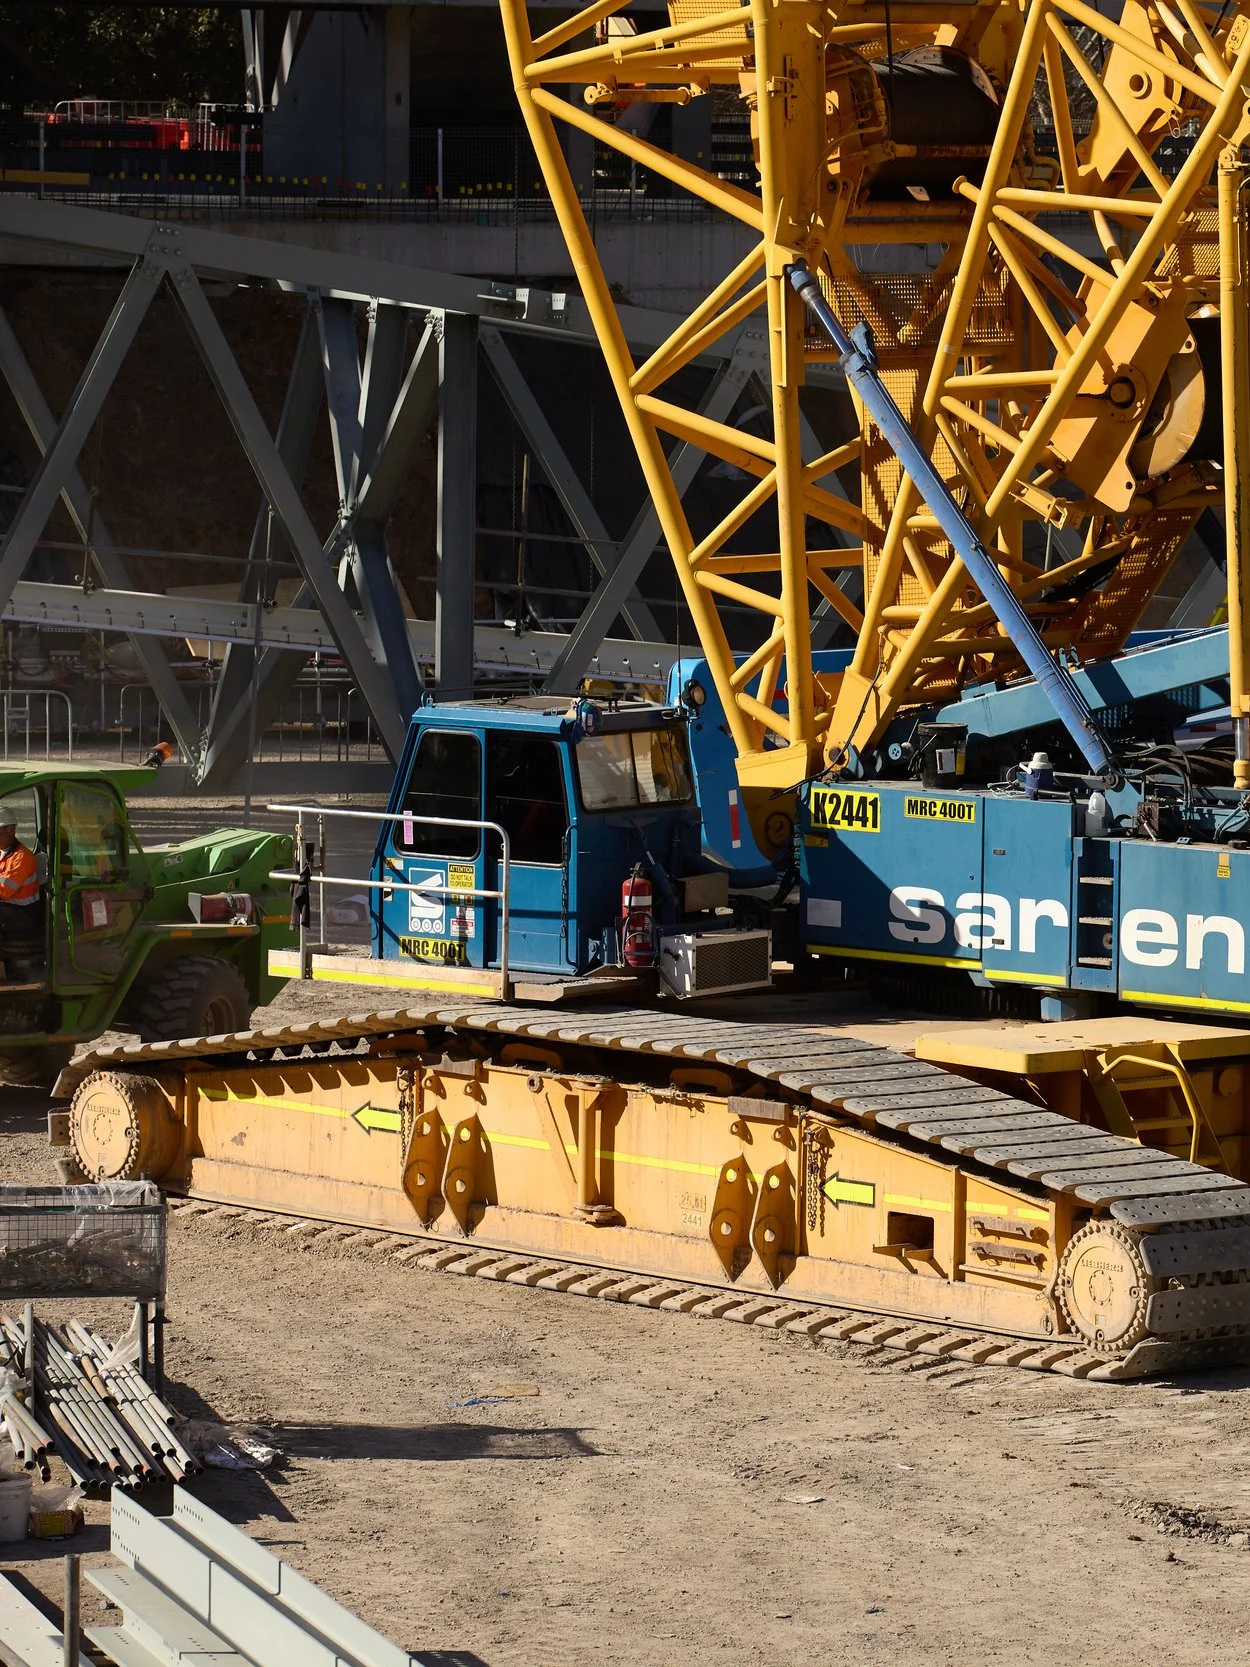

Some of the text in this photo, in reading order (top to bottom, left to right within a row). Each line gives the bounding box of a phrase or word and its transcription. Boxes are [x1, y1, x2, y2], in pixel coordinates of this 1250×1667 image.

[813, 792, 879, 829] K2441
[907, 799, 974, 820] MRC 400T
[449, 865, 473, 873] ATTENTION
[402, 938, 465, 961] MRC 400T
[683, 1212, 702, 1227] 2441
[1081, 1259, 1123, 1273] LIEBHERR
